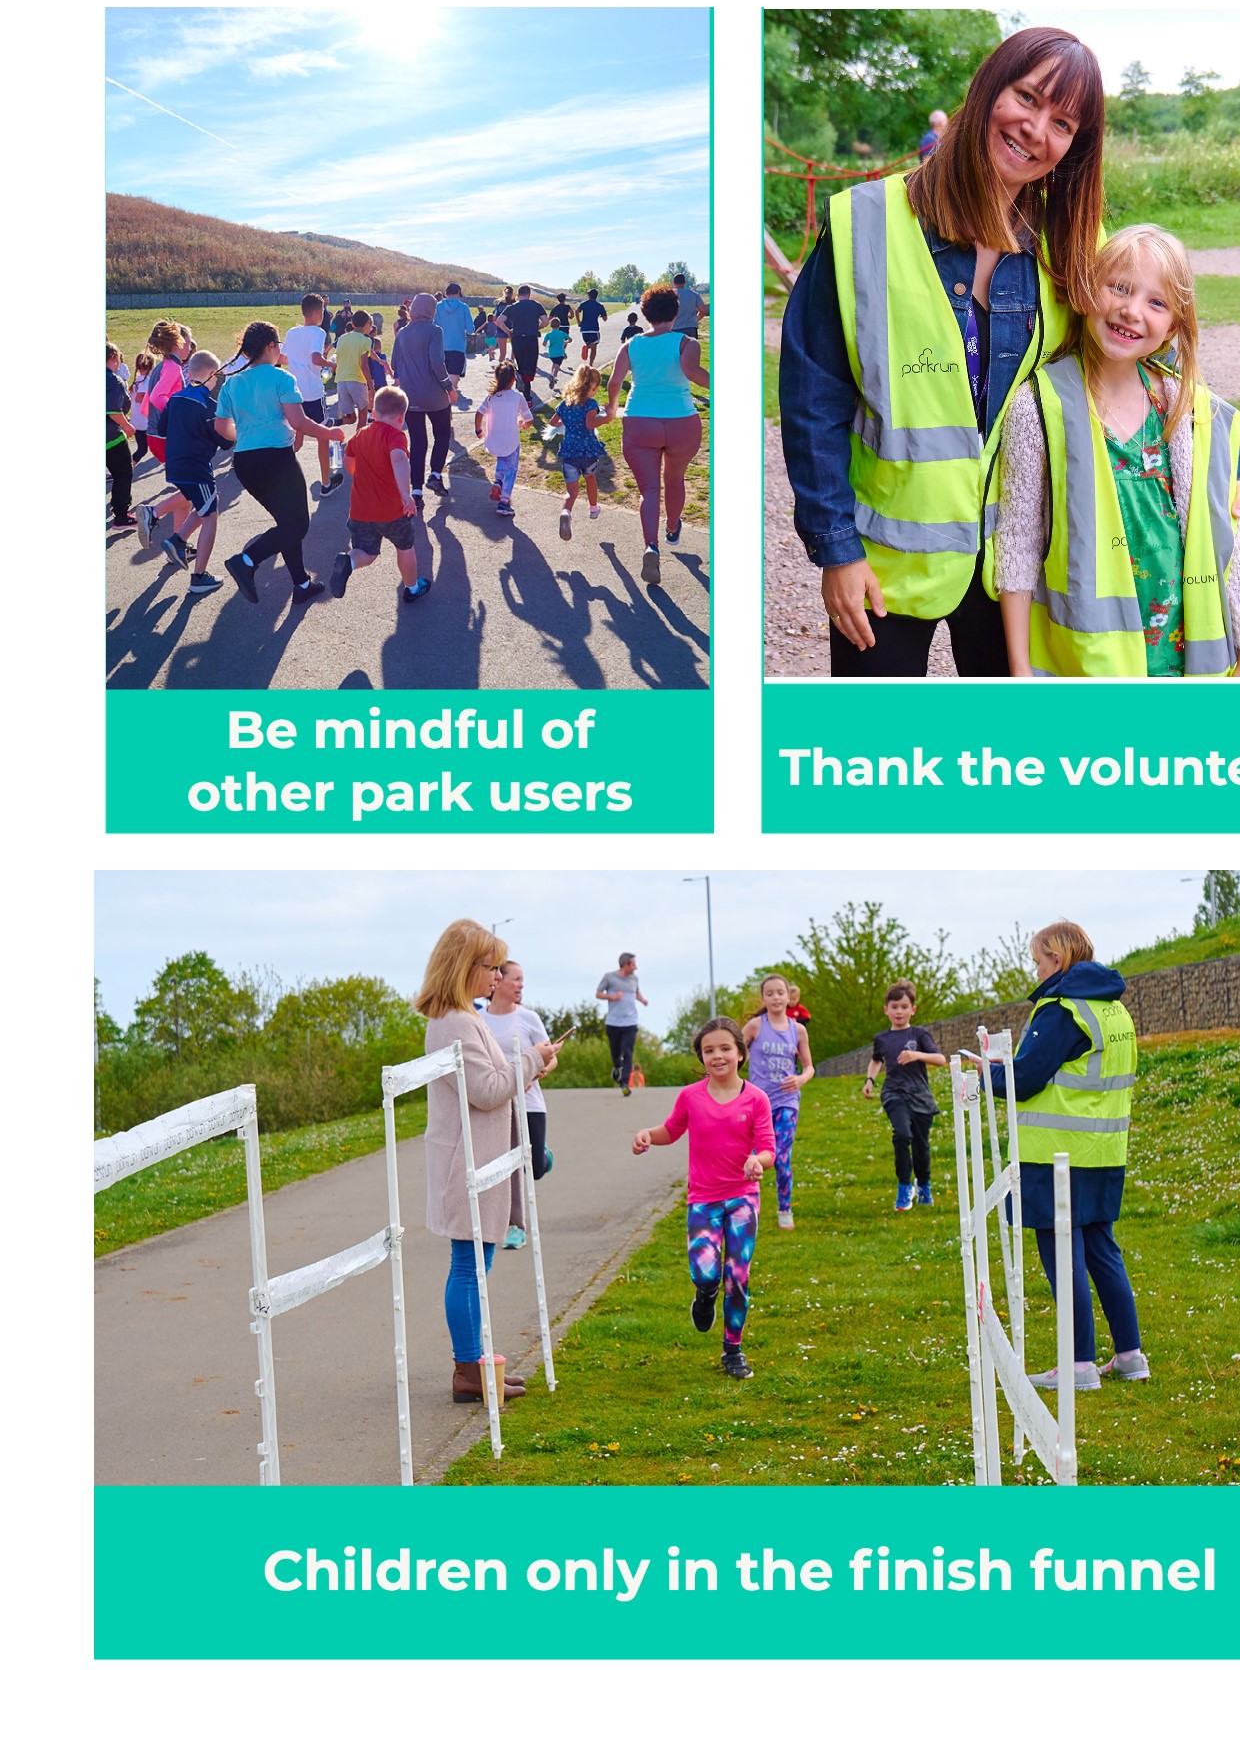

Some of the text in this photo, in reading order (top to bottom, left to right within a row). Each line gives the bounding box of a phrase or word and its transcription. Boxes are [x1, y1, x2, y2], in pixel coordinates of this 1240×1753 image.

[902, 348, 959, 377] parkrun
[229, 706, 596, 749] Be mindful of
[779, 747, 944, 786] Thank
[957, 747, 1045, 786] the
[188, 771, 632, 821] other park users
[264, 1546, 1215, 1602] Children only in the finish funnel
